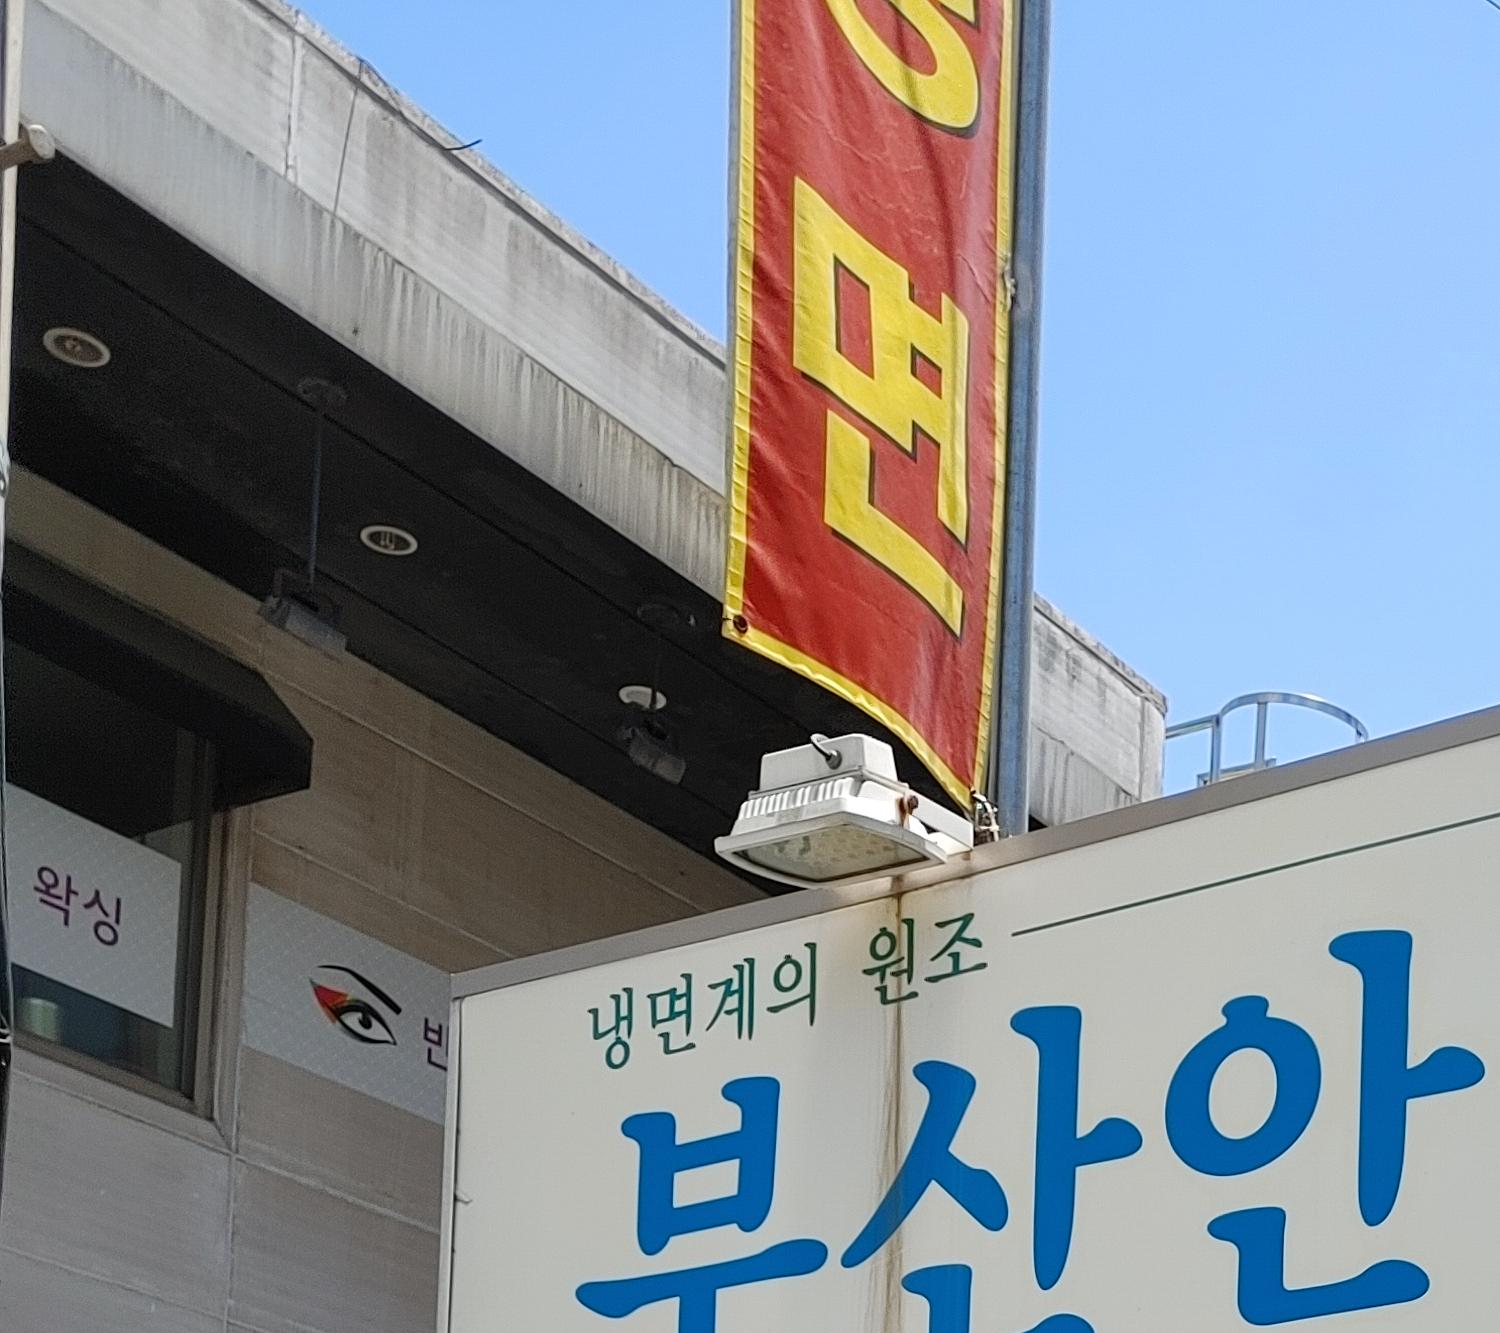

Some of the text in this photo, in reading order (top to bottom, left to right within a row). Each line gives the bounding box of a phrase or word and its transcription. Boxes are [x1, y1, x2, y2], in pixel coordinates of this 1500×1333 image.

[33, 865, 122, 947] 왁싱
[588, 912, 988, 1069] 냉면계의 원조
